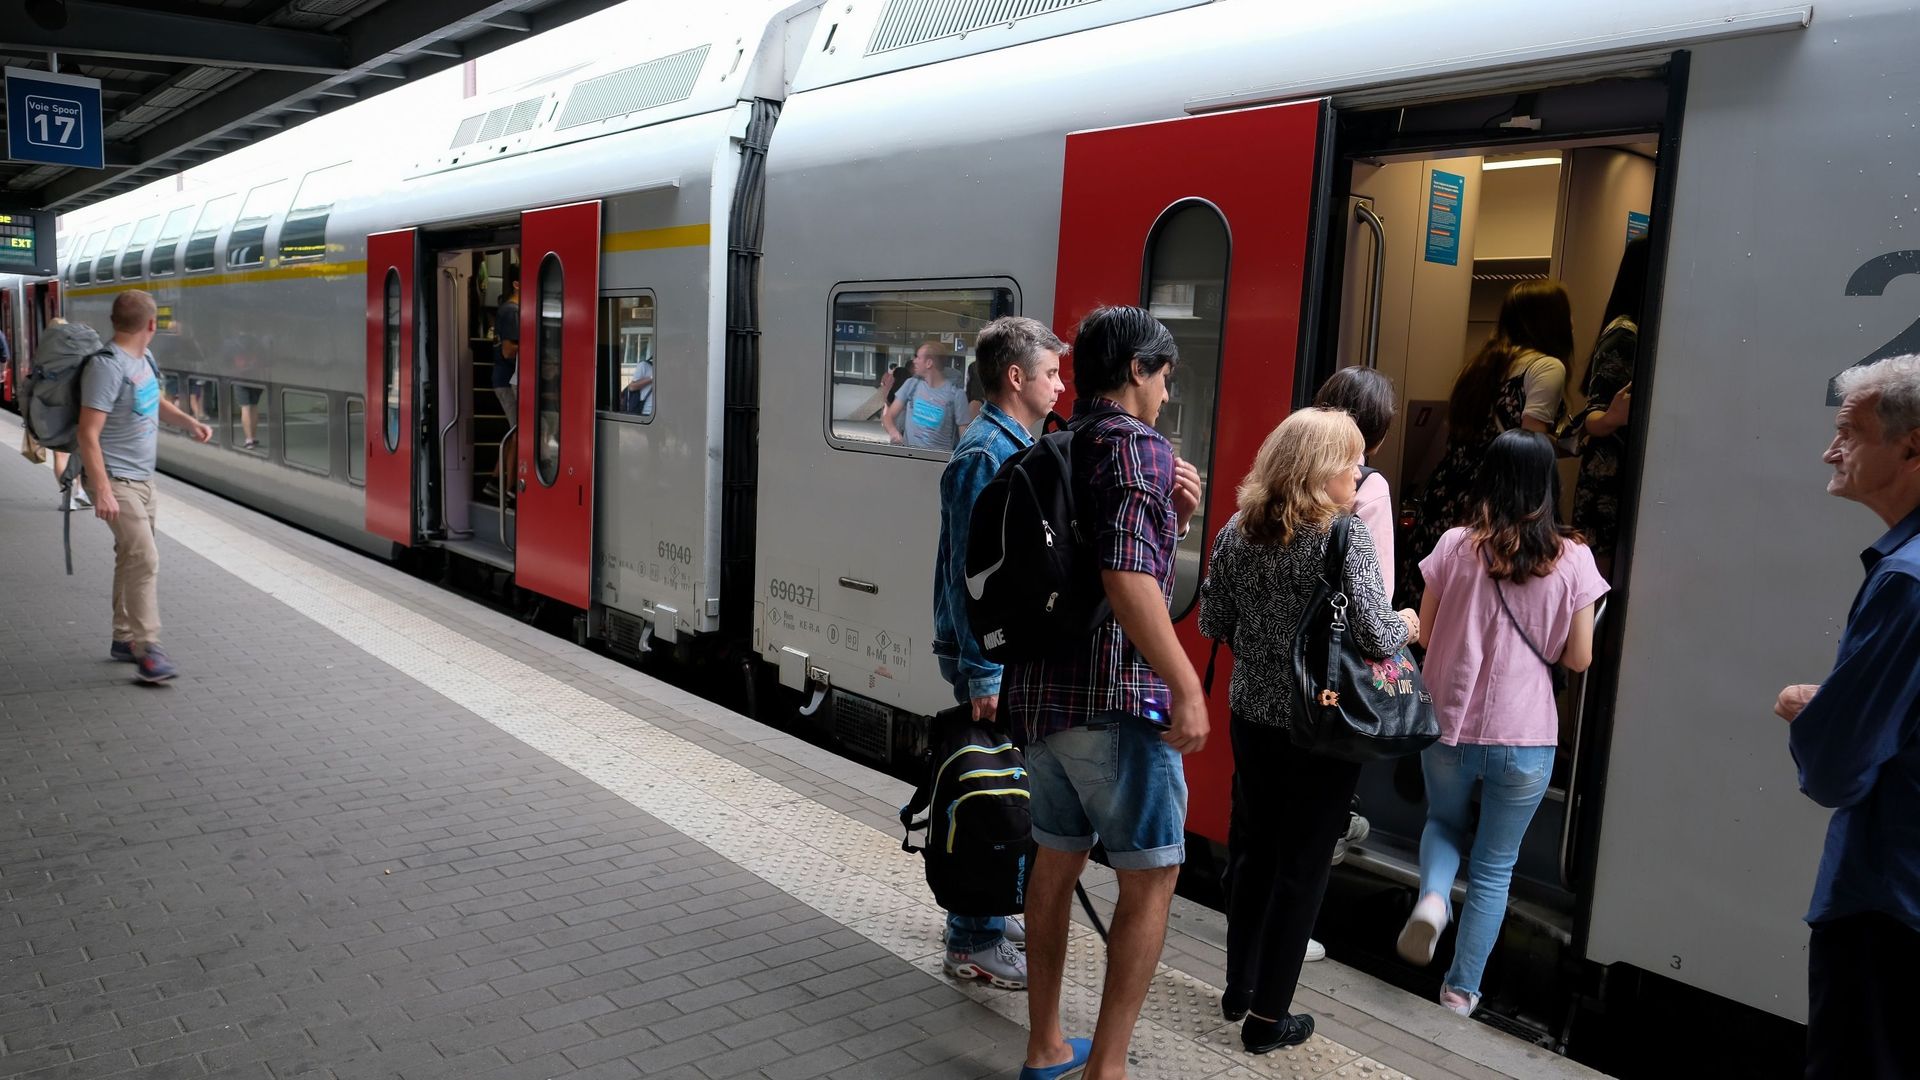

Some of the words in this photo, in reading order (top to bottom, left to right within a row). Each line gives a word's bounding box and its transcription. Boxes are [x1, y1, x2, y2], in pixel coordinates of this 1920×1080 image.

[29, 101, 50, 111] Voie
[52, 104, 79, 115] Spoor
[34, 113, 75, 144] 17
[11, 237, 33, 249] EXT
[658, 540, 691, 565] 61040
[770, 578, 816, 608] 69037
[983, 628, 1006, 651] NIKE
[1397, 679, 1414, 695] LOVE
[1670, 955, 1682, 970] 3
